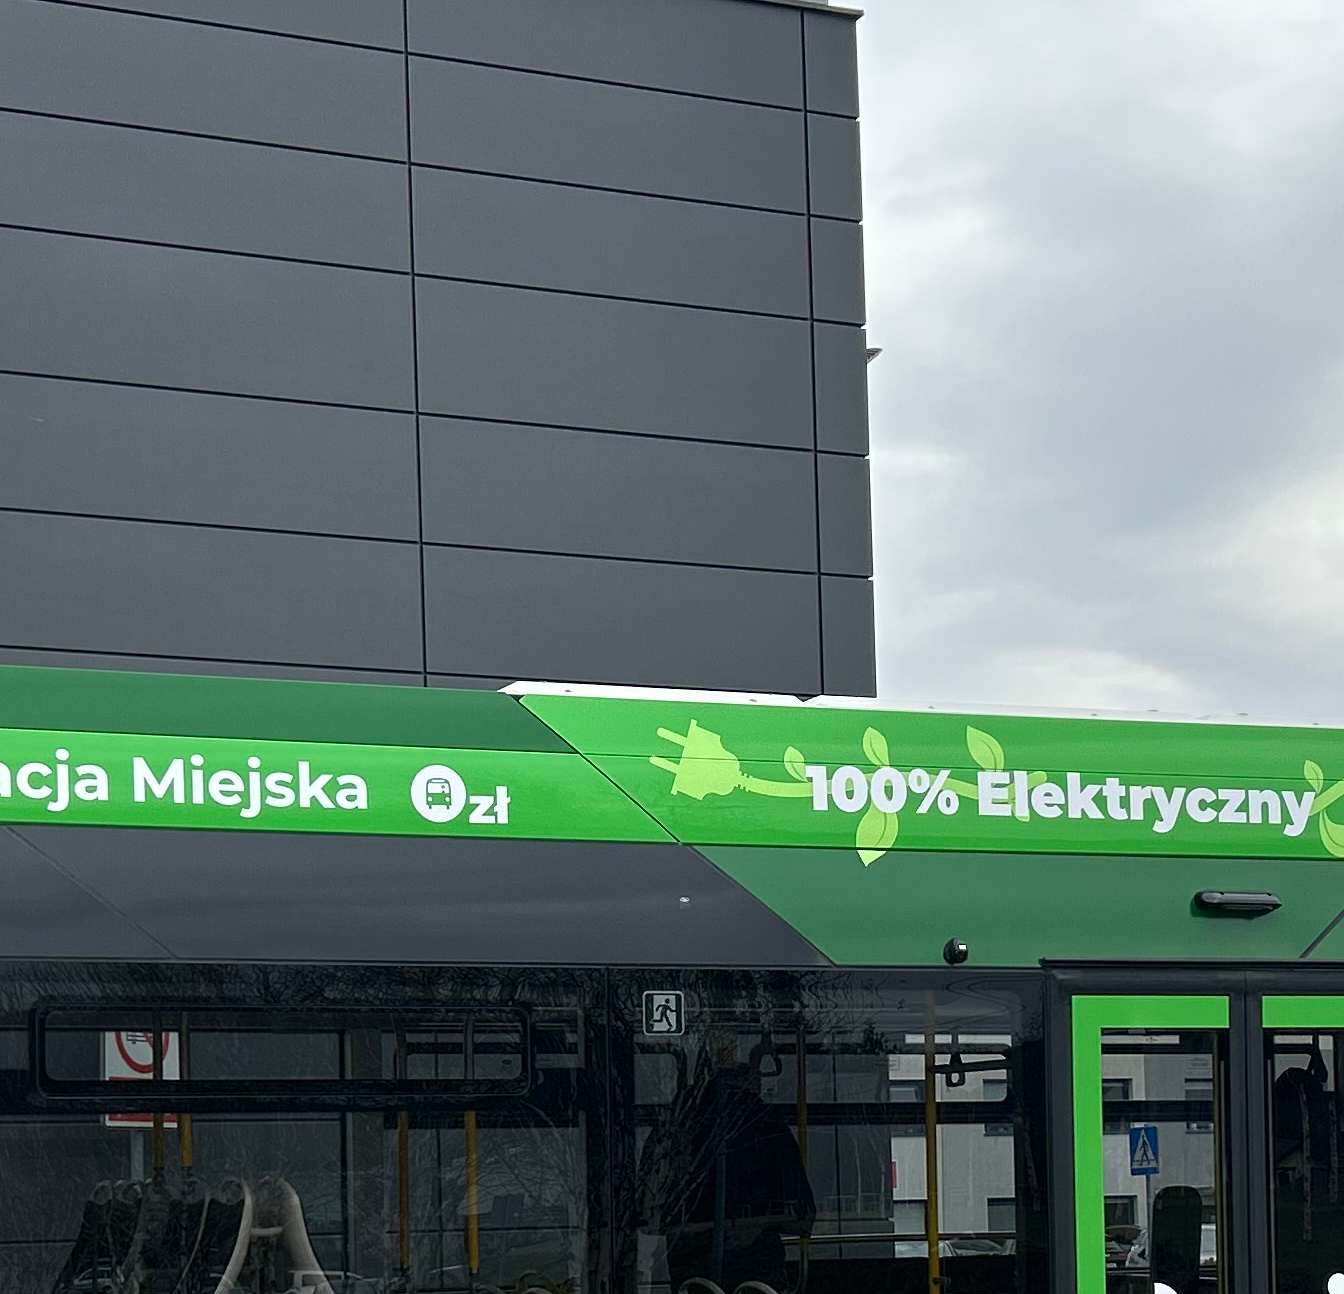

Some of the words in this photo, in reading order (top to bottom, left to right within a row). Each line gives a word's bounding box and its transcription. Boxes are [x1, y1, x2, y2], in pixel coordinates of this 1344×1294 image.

[132, 754, 368, 819] Miejska
[805, 765, 959, 815] 100%
[977, 769, 1316, 838] Elektryczny
